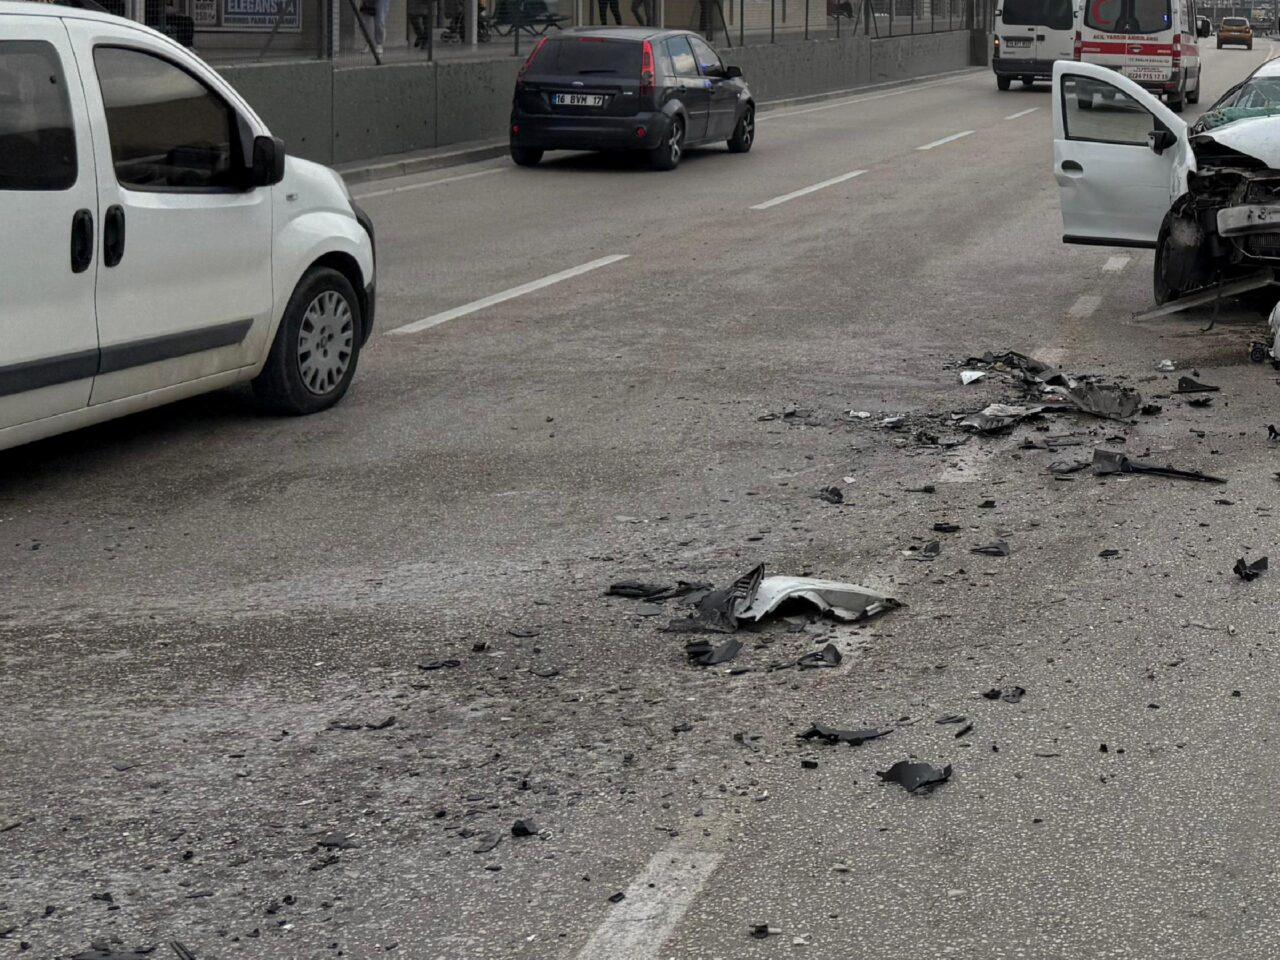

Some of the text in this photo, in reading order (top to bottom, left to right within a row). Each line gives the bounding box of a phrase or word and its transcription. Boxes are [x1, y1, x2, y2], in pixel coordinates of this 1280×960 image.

[557, 95, 602, 105] 16 BVM 17
